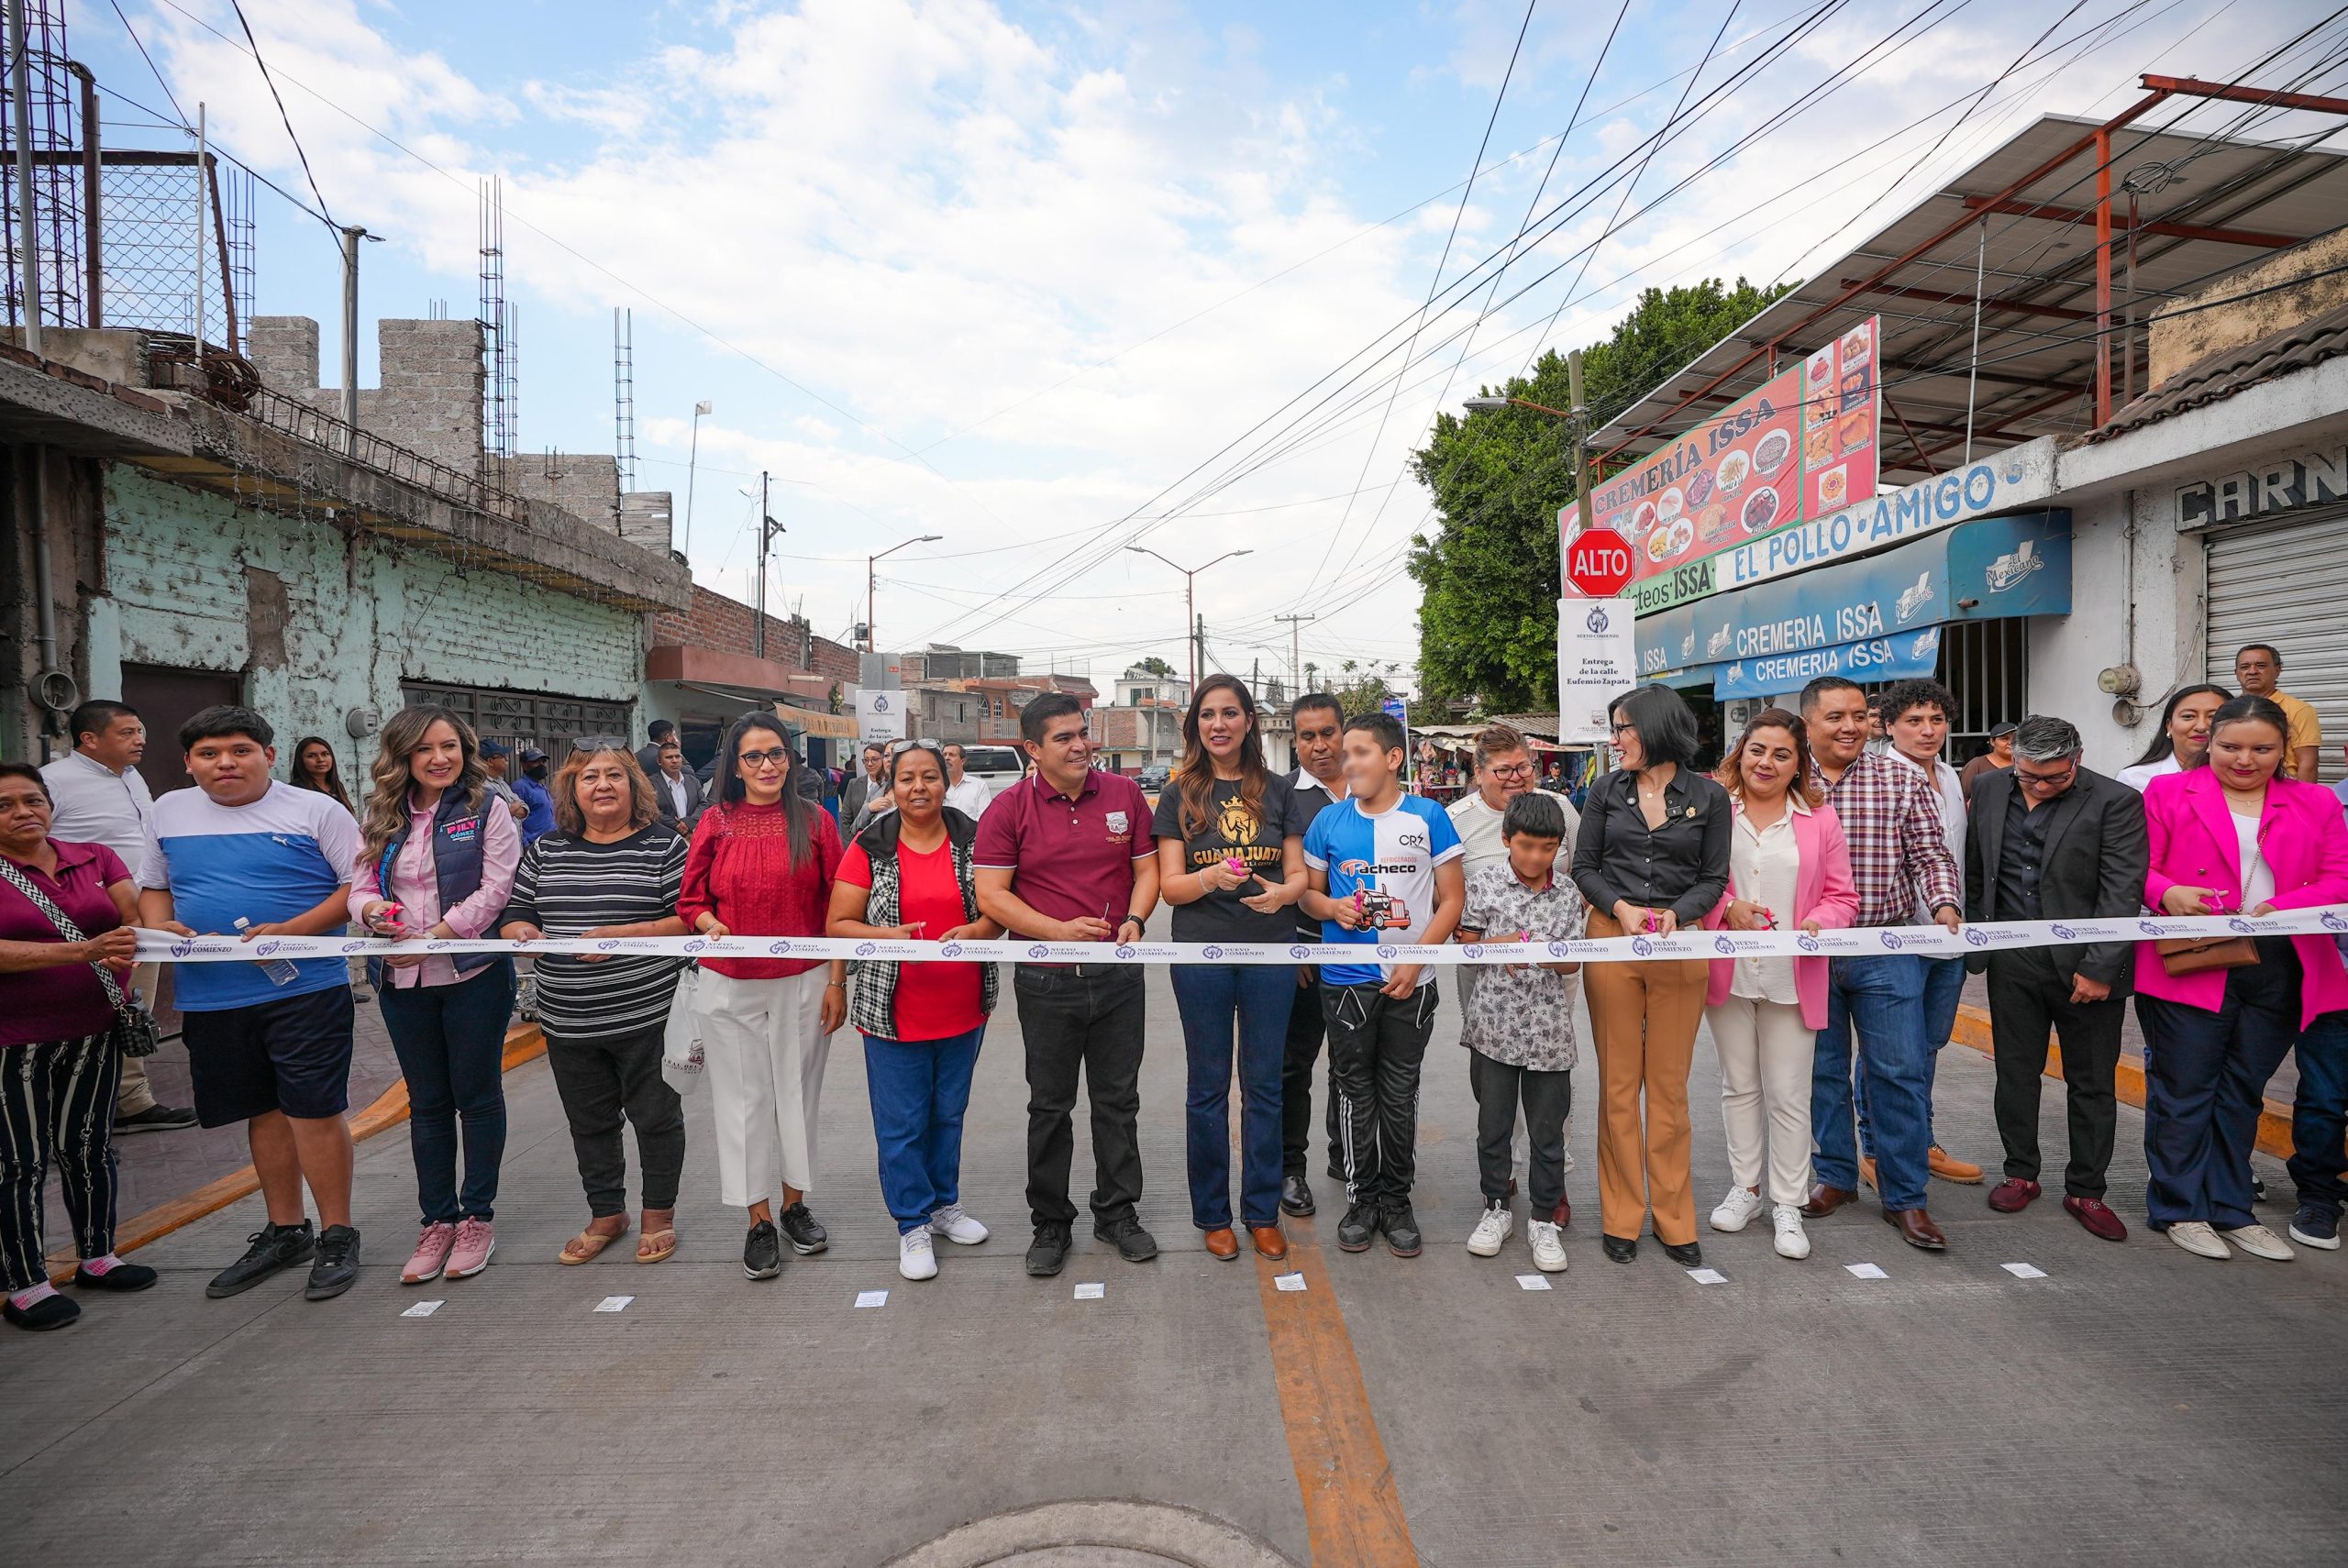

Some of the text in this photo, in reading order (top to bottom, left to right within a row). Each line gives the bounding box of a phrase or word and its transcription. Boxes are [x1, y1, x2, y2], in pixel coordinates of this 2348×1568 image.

[1594, 397, 1777, 515] CREMERÍA ISSA
[2175, 444, 2348, 534] CARN
[1735, 466, 1995, 582] EL POLLO AMIGO
[1574, 548, 1628, 577] ALTO
[1987, 556, 2040, 584] Mexicano
[1673, 562, 1711, 600] ISSA
[1736, 601, 1884, 657] CREMERIA ISSA
[1582, 657, 1614, 668] Entrega
[1644, 646, 1667, 673] ISSA
[1755, 639, 1895, 682] CREMERIA ISSA
[1602, 678, 1631, 687] Zapata
[1193, 846, 1282, 865] GUANAJUATO
[1339, 859, 1417, 877] Pacheco
[1902, 937, 1944, 945] COMIENZO
[1988, 933, 2030, 941] COMIENZO
